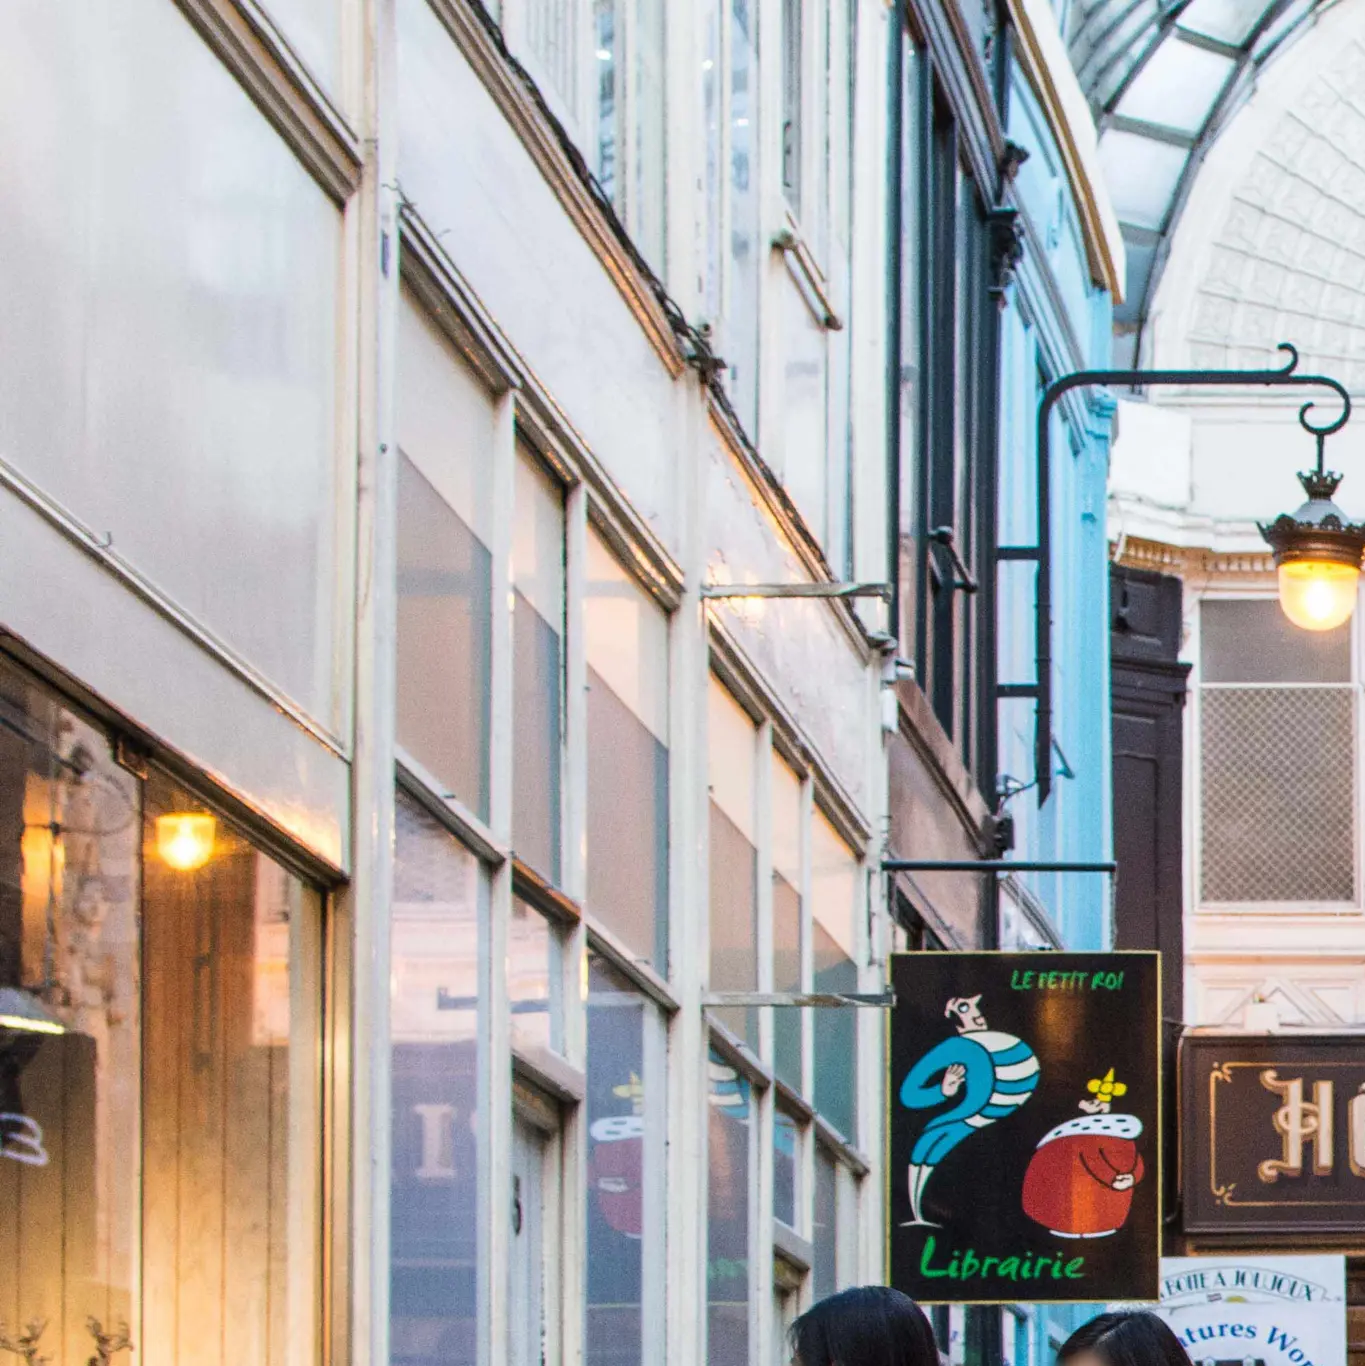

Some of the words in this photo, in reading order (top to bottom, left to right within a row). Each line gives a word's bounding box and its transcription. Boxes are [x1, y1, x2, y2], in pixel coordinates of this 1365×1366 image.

[1011, 970, 1033, 990] LE
[1039, 971, 1088, 991] PETIT
[1091, 971, 1126, 990] ROI
[919, 1236, 1087, 1281] Librairie
[1213, 1269, 1226, 1288] A
[1178, 1323, 1258, 1348] tures
